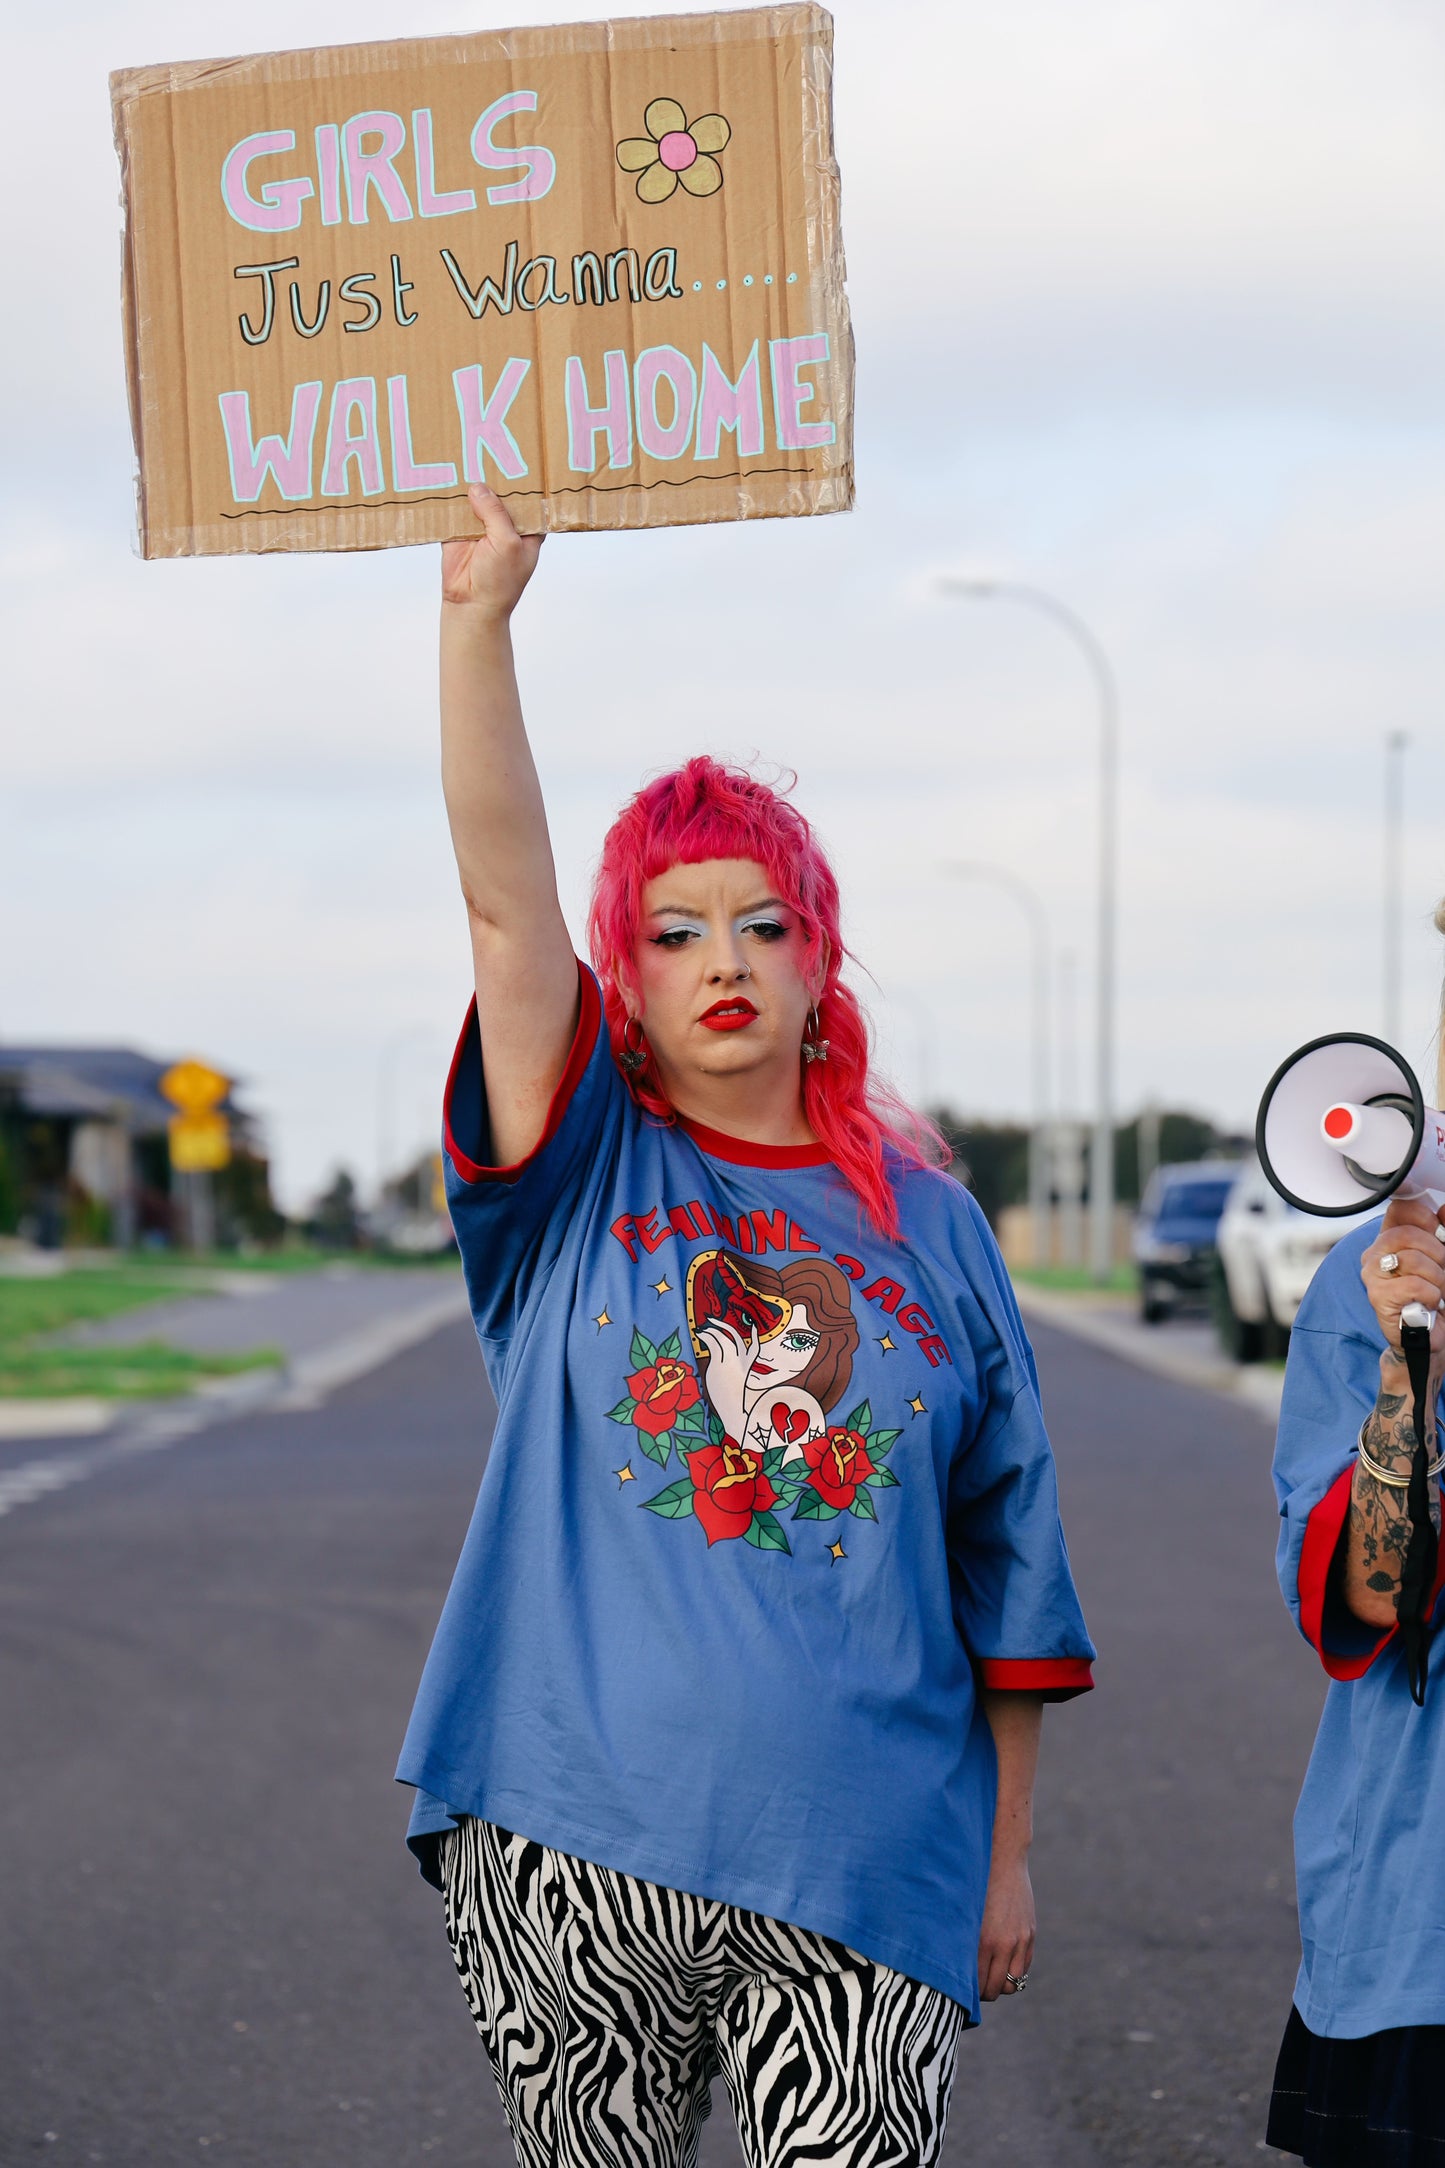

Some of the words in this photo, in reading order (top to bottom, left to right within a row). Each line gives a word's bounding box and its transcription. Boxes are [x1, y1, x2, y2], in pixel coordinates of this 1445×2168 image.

[220, 90, 556, 233] GIRLS
[234, 254, 419, 346] Just
[218, 356, 532, 503] WALK
[564, 332, 837, 474] HOME
